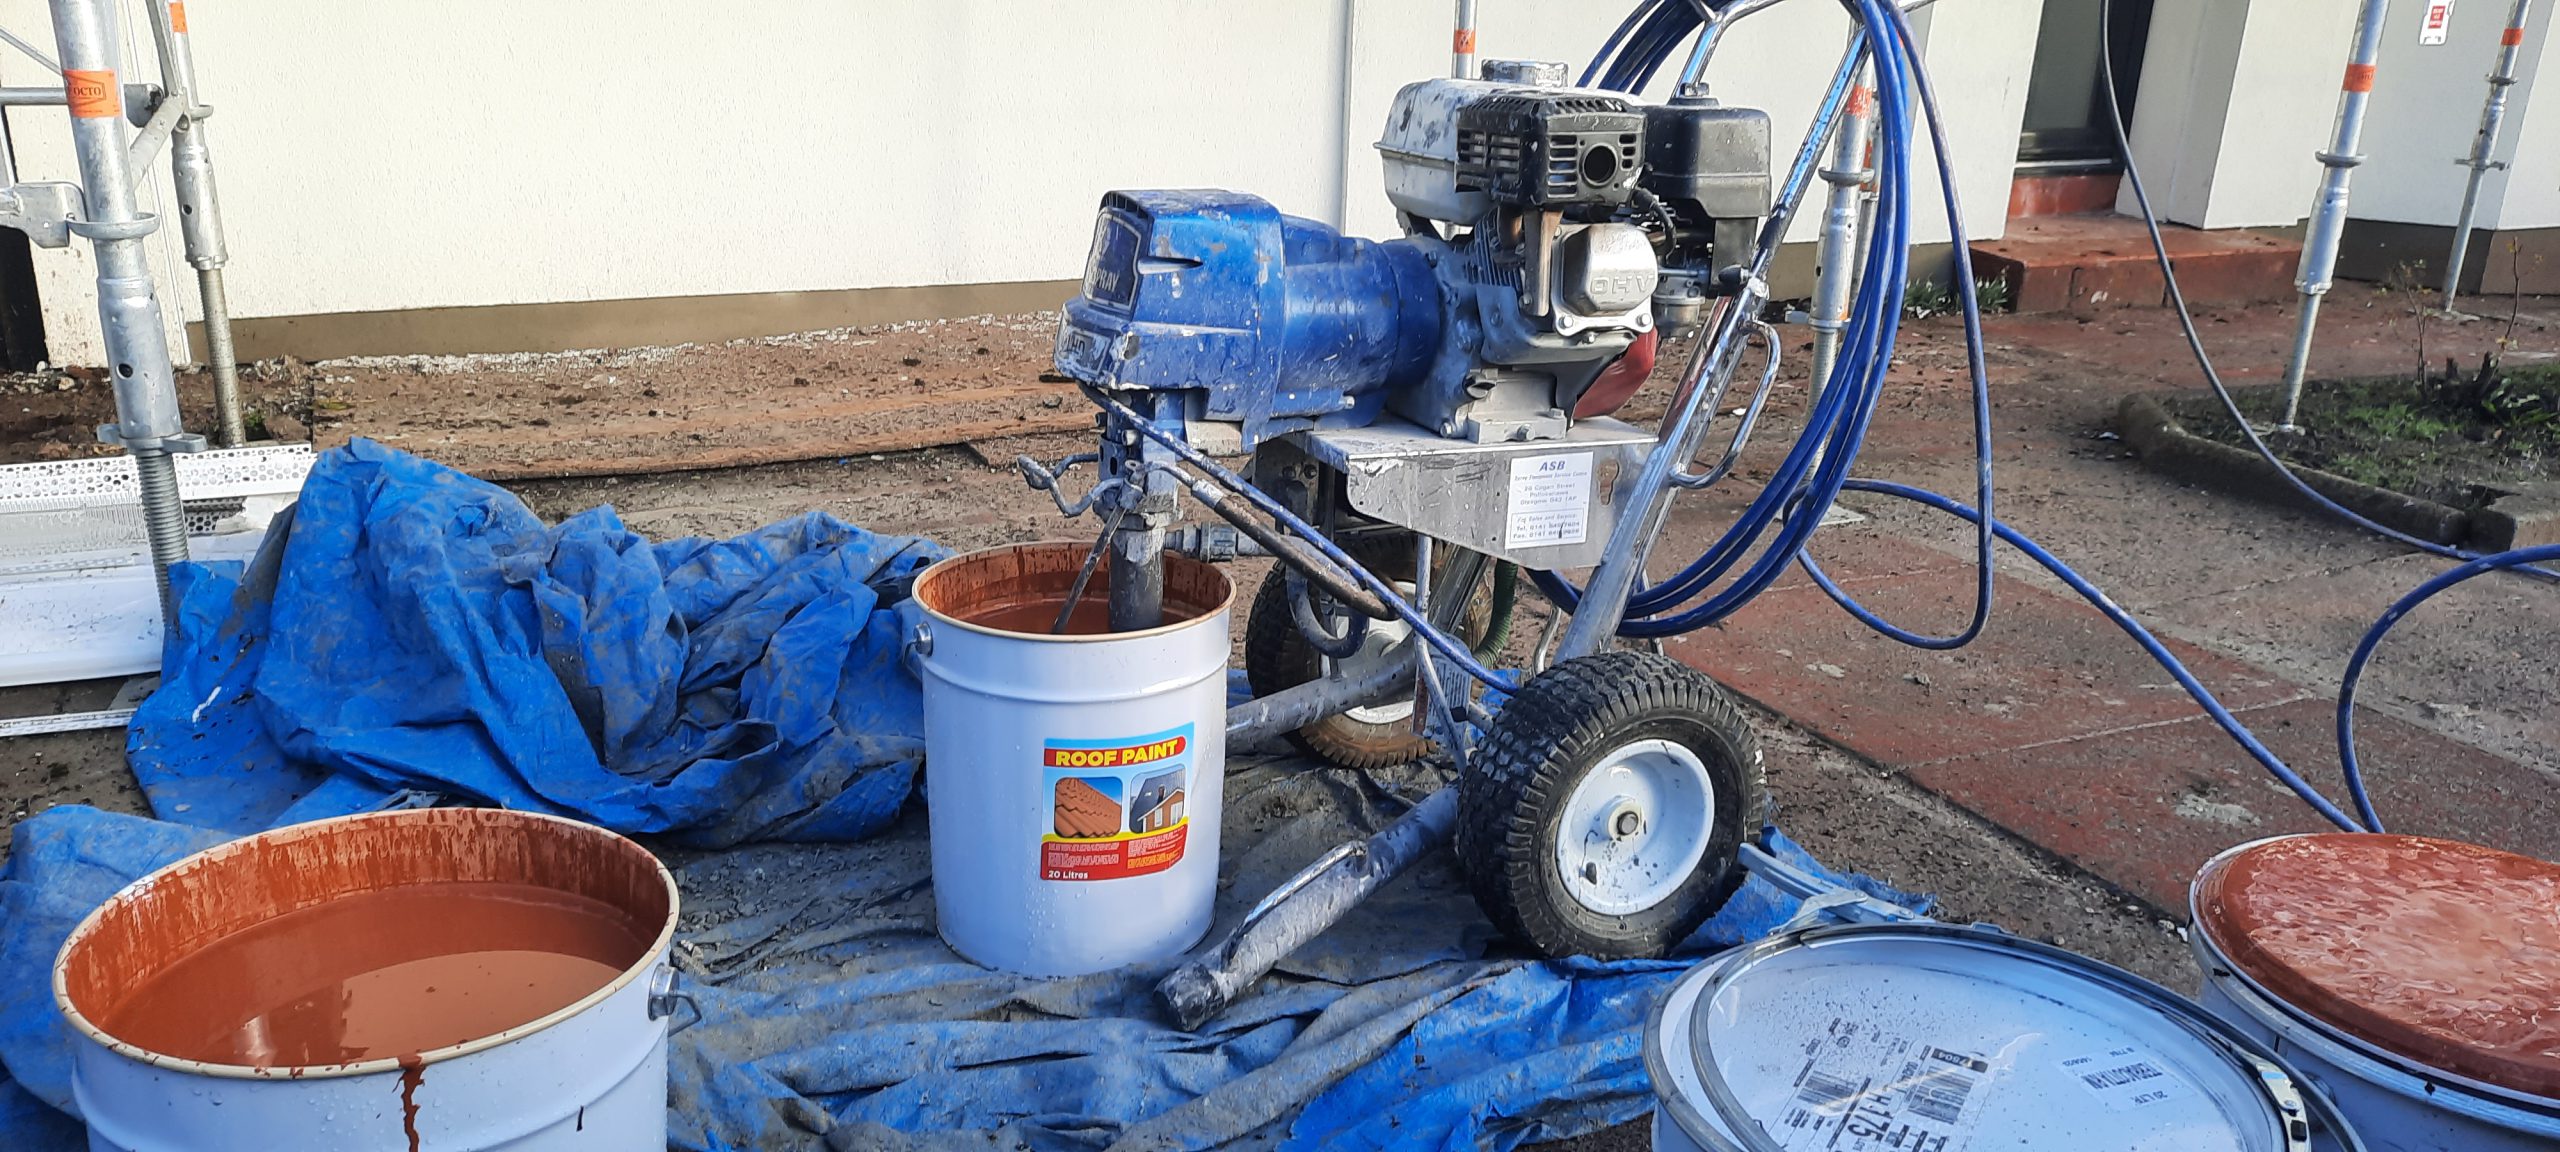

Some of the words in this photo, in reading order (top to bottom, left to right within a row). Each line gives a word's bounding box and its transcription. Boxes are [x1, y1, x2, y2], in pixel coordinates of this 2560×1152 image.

[73, 86, 102, 96] OCTO
[1589, 274, 1655, 295] OHV
[1539, 460, 1566, 472] ASB
[1055, 750, 1117, 767] ROOF
[1121, 739, 1178, 765] PAINT
[1048, 870, 1061, 878] 20
[1062, 870, 1089, 879] Litres
